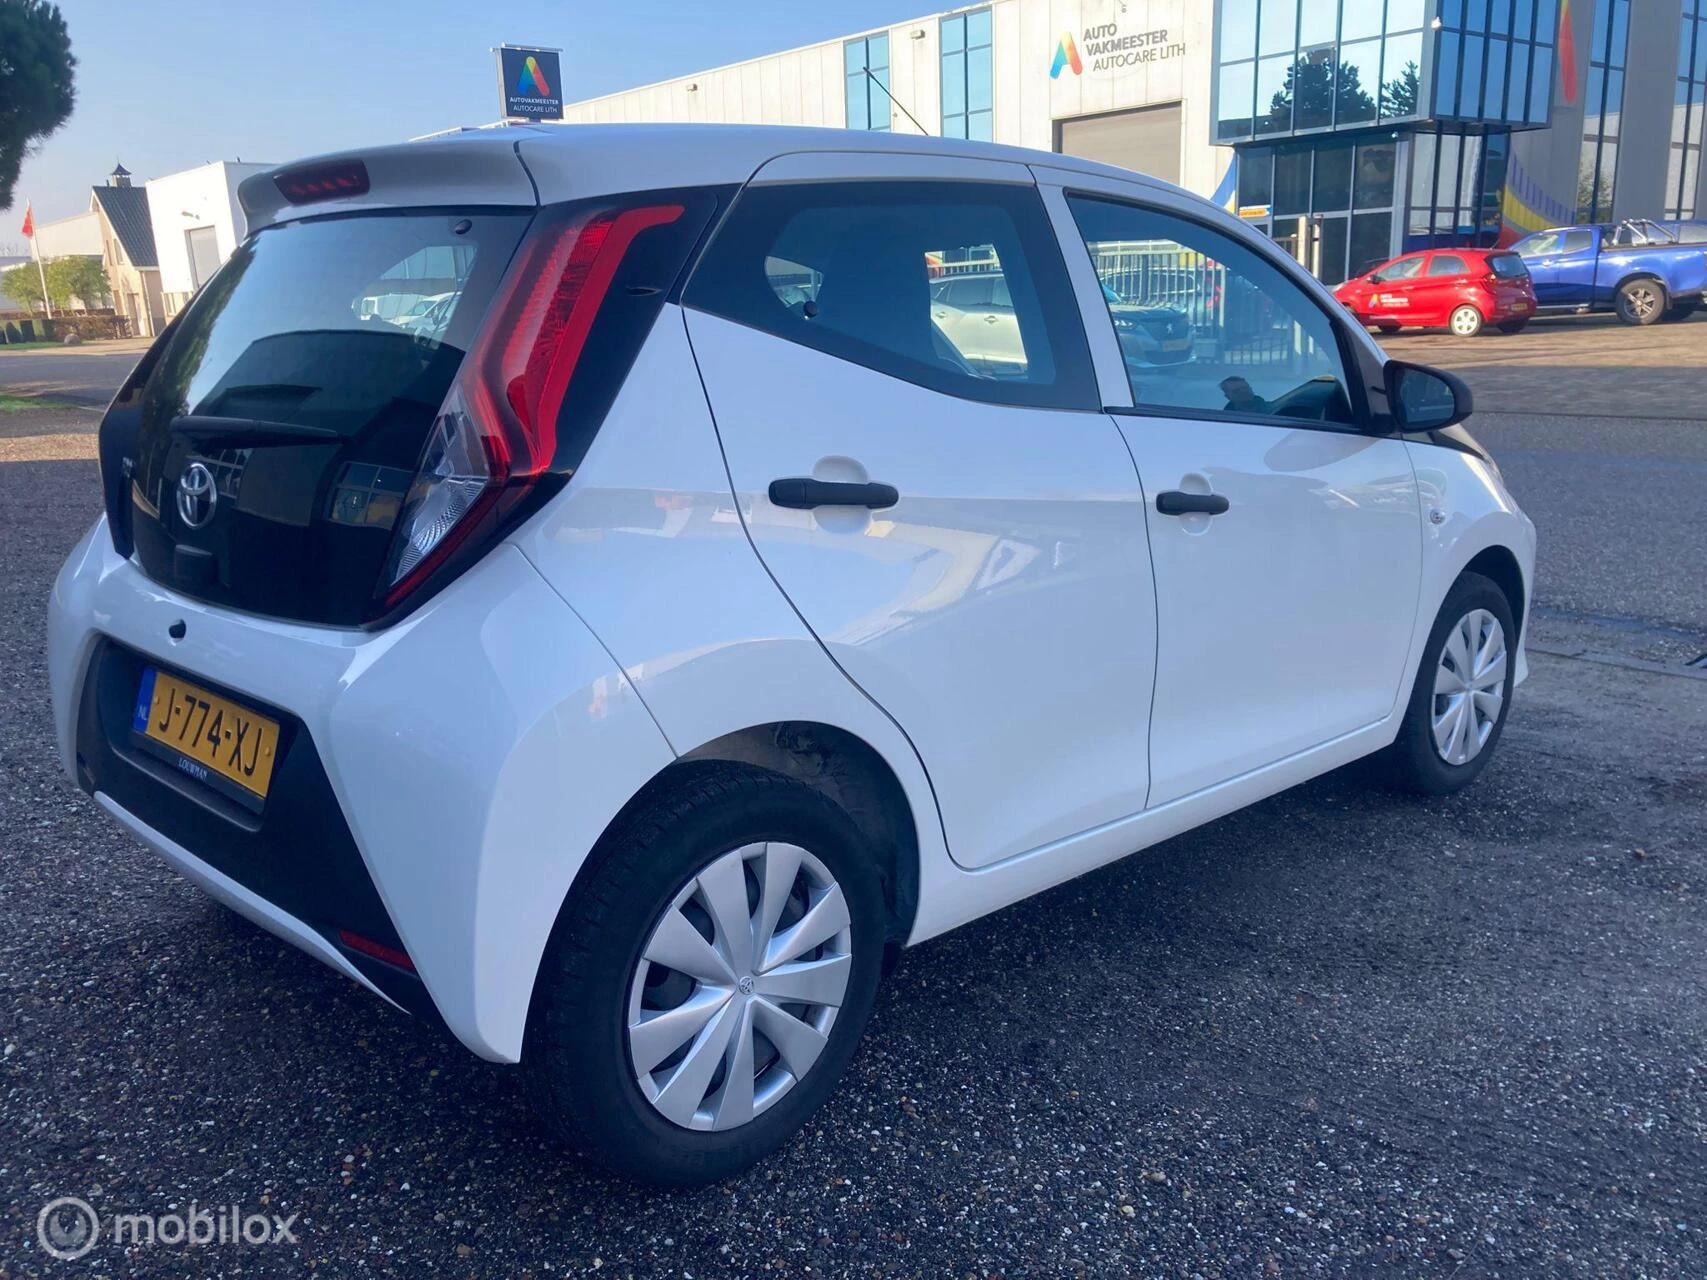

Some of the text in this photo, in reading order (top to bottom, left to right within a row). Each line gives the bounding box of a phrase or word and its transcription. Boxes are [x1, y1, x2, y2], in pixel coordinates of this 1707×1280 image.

[1083, 23, 1117, 41] AUTO
[1086, 29, 1168, 56] VAKMEESTER
[1093, 43, 1186, 72] AUTOCARE LITH
[509, 97, 559, 105] AUTOVAKMEESTER
[513, 105, 544, 113] AUTOCARE
[137, 705, 147, 721] NL
[159, 688, 263, 777] J-774-XJ
